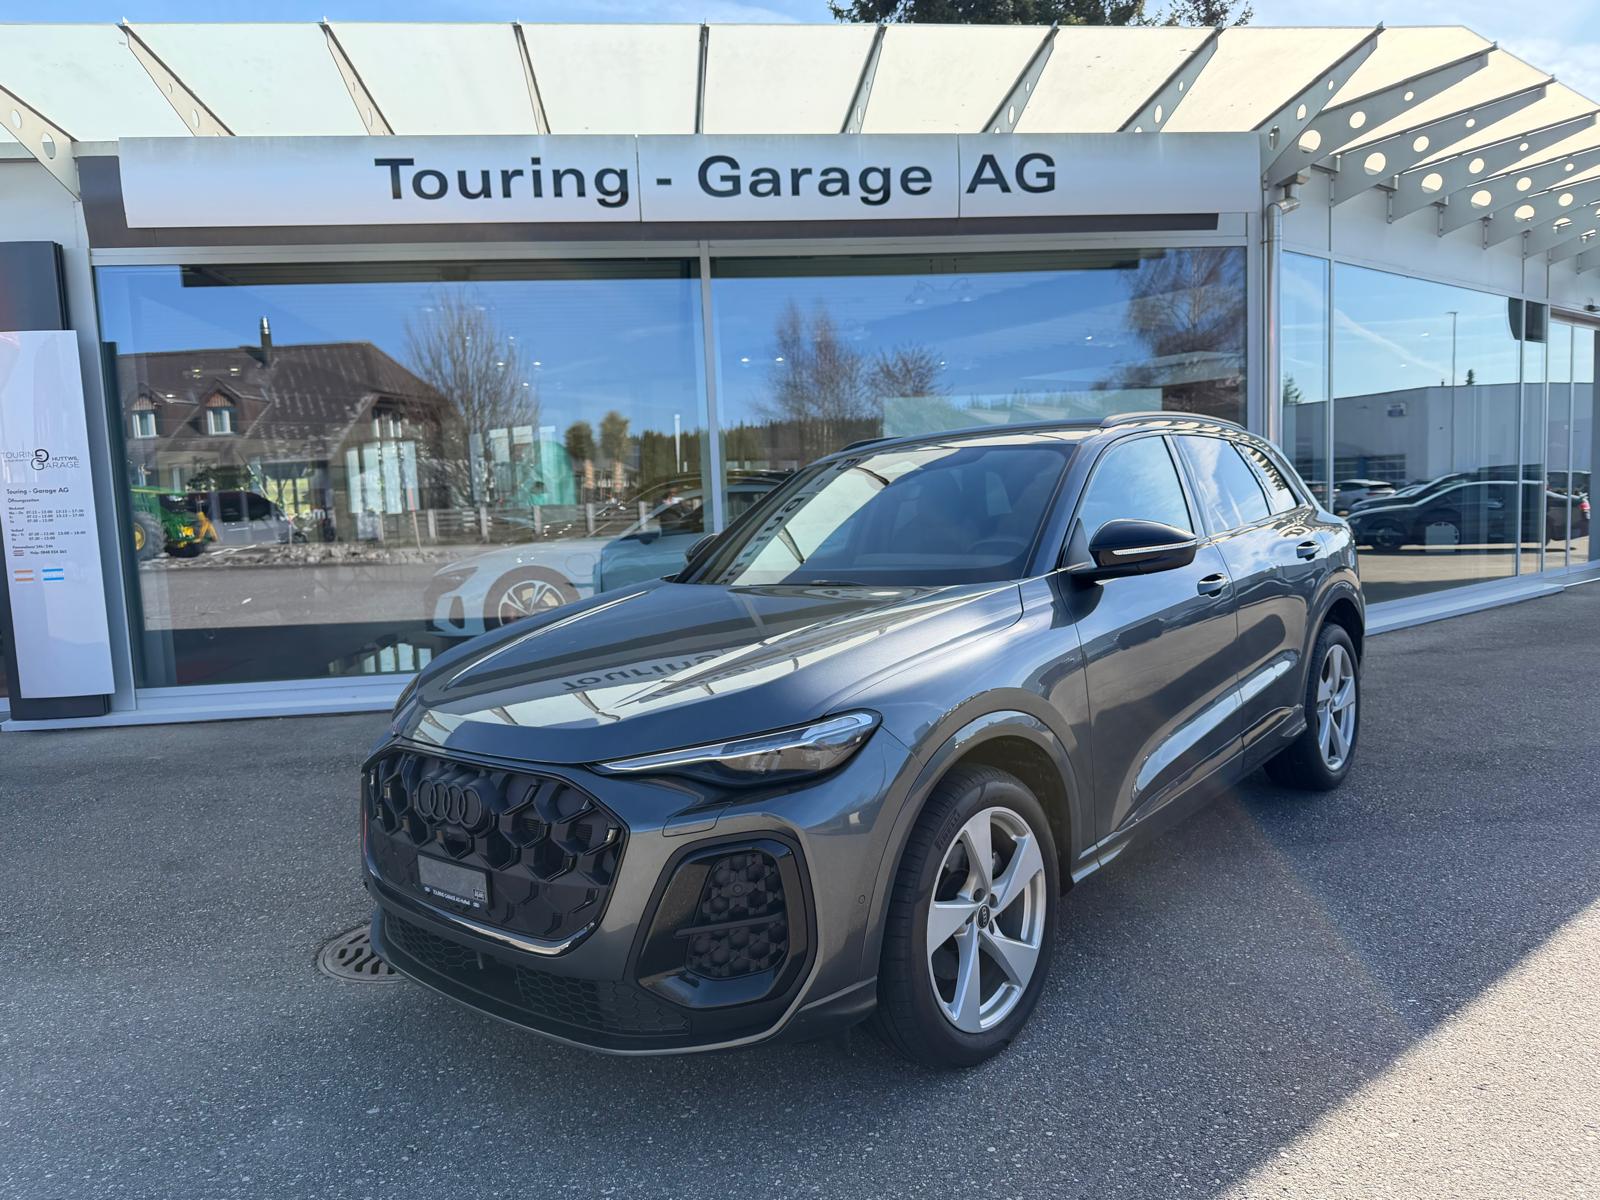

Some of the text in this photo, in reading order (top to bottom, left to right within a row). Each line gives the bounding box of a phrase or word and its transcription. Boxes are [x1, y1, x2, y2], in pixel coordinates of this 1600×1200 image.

[374, 152, 1057, 208] Touring - Garage AG
